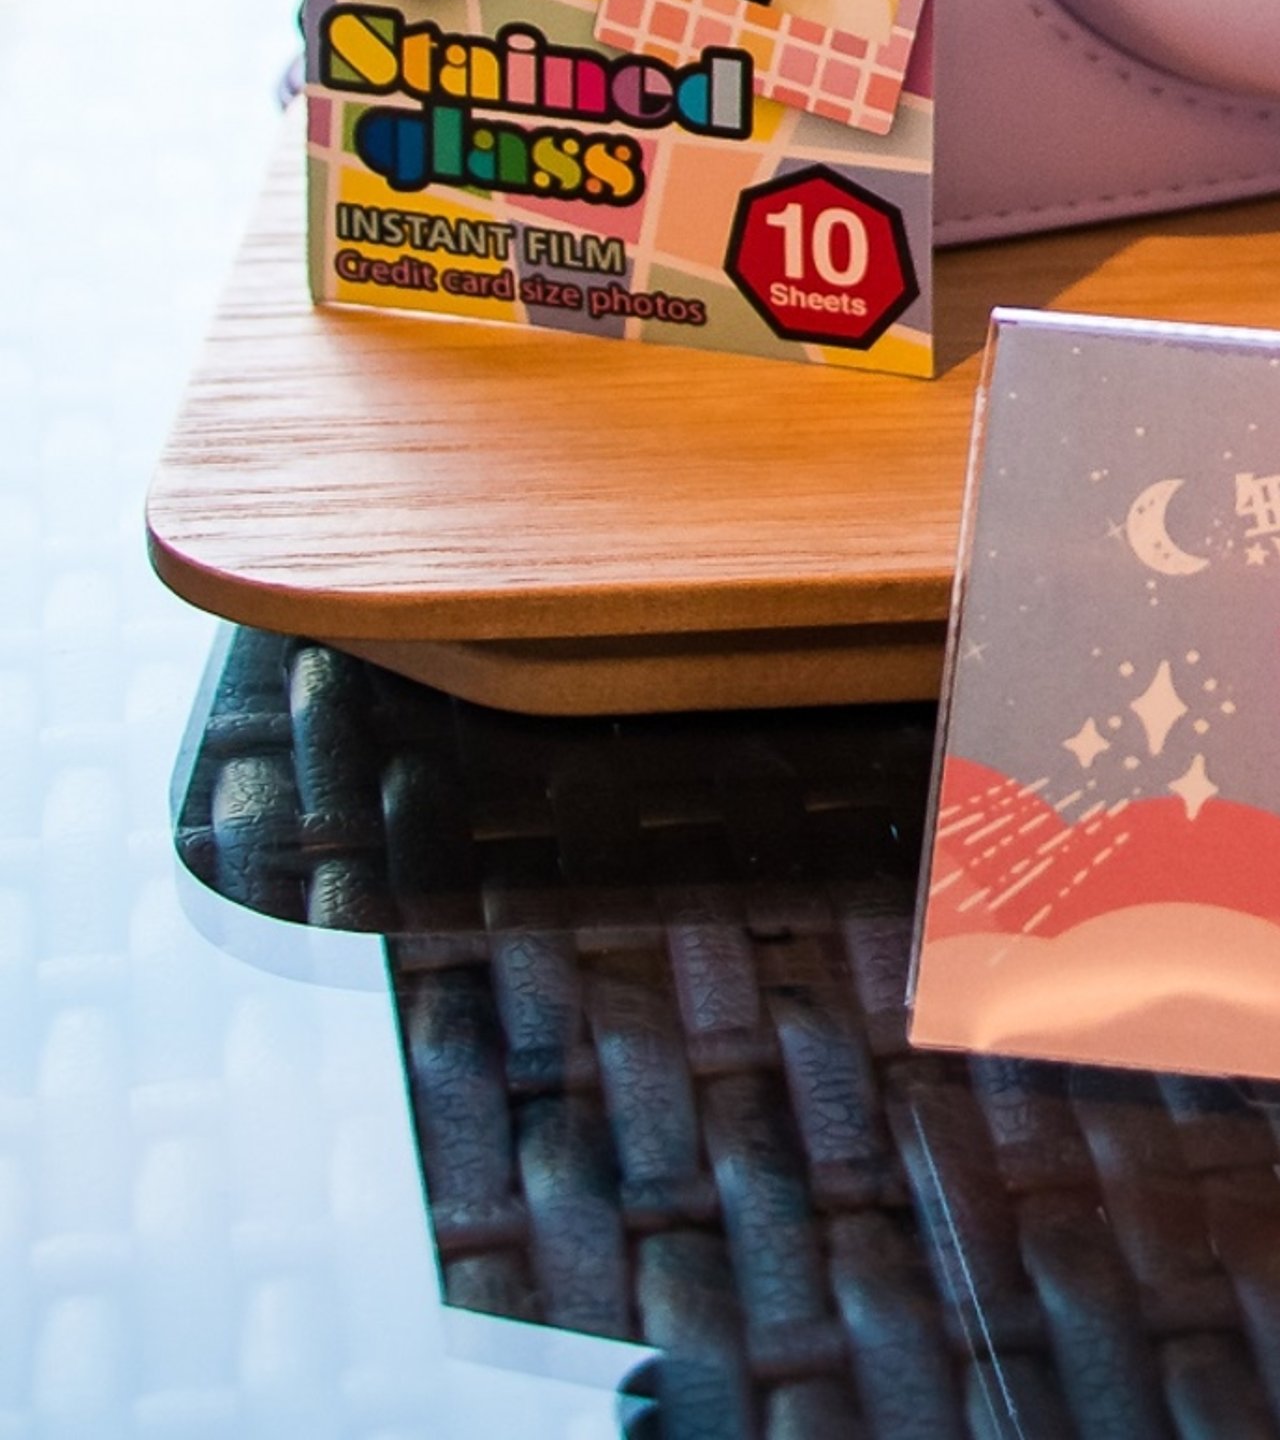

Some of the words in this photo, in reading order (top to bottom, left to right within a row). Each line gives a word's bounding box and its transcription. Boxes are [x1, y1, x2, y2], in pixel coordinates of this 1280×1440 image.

[320, 4, 752, 139] Stained
[355, 103, 644, 207] glass
[337, 204, 514, 261] INSTANT
[523, 228, 626, 274] FILM
[765, 203, 869, 287] 10
[336, 251, 439, 294] Credit
[443, 266, 514, 300] card
[520, 275, 580, 309] size
[590, 283, 707, 326] photos
[769, 282, 867, 317] Sheets
